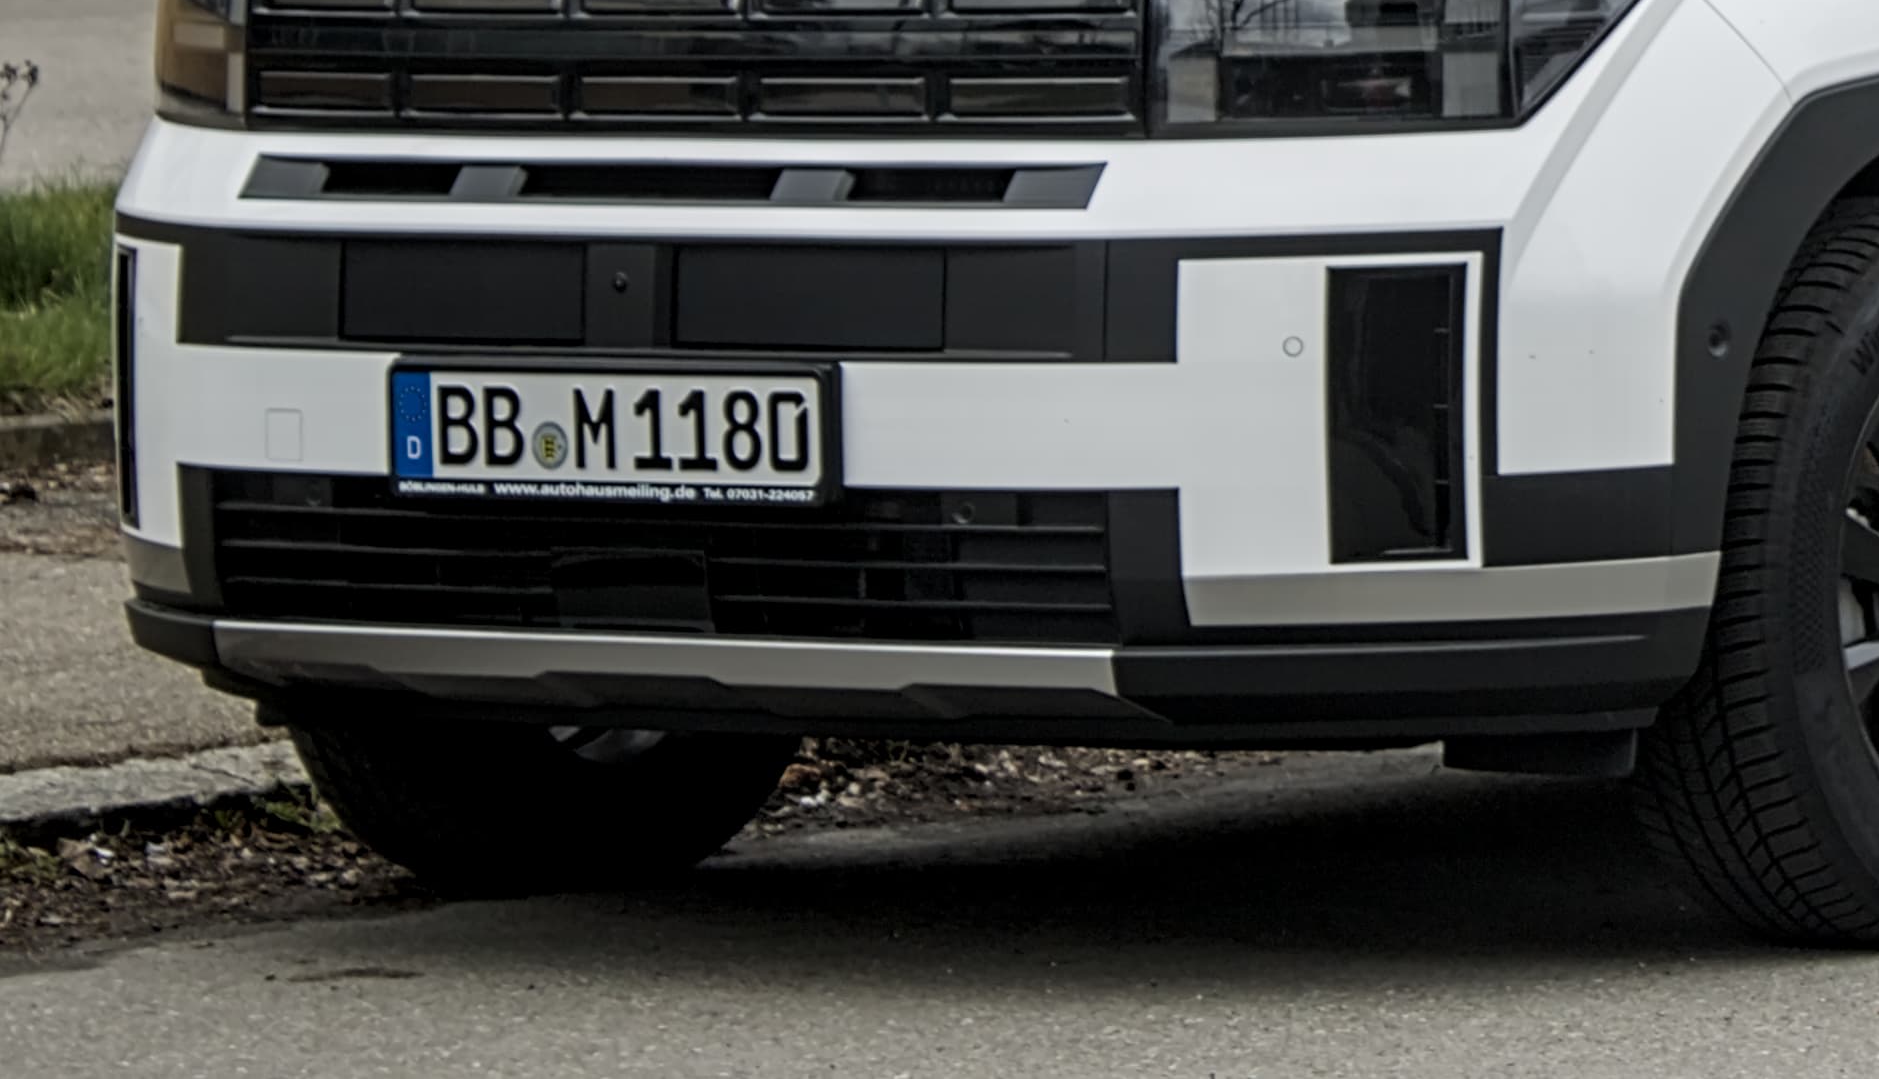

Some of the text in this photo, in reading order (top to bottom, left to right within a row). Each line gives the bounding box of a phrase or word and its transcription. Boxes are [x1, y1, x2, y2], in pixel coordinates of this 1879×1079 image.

[438, 386, 524, 468] BB
[634, 388, 808, 471] 1180
[406, 435, 421, 459] D
[494, 482, 695, 501] www.autohausmeiling.de
